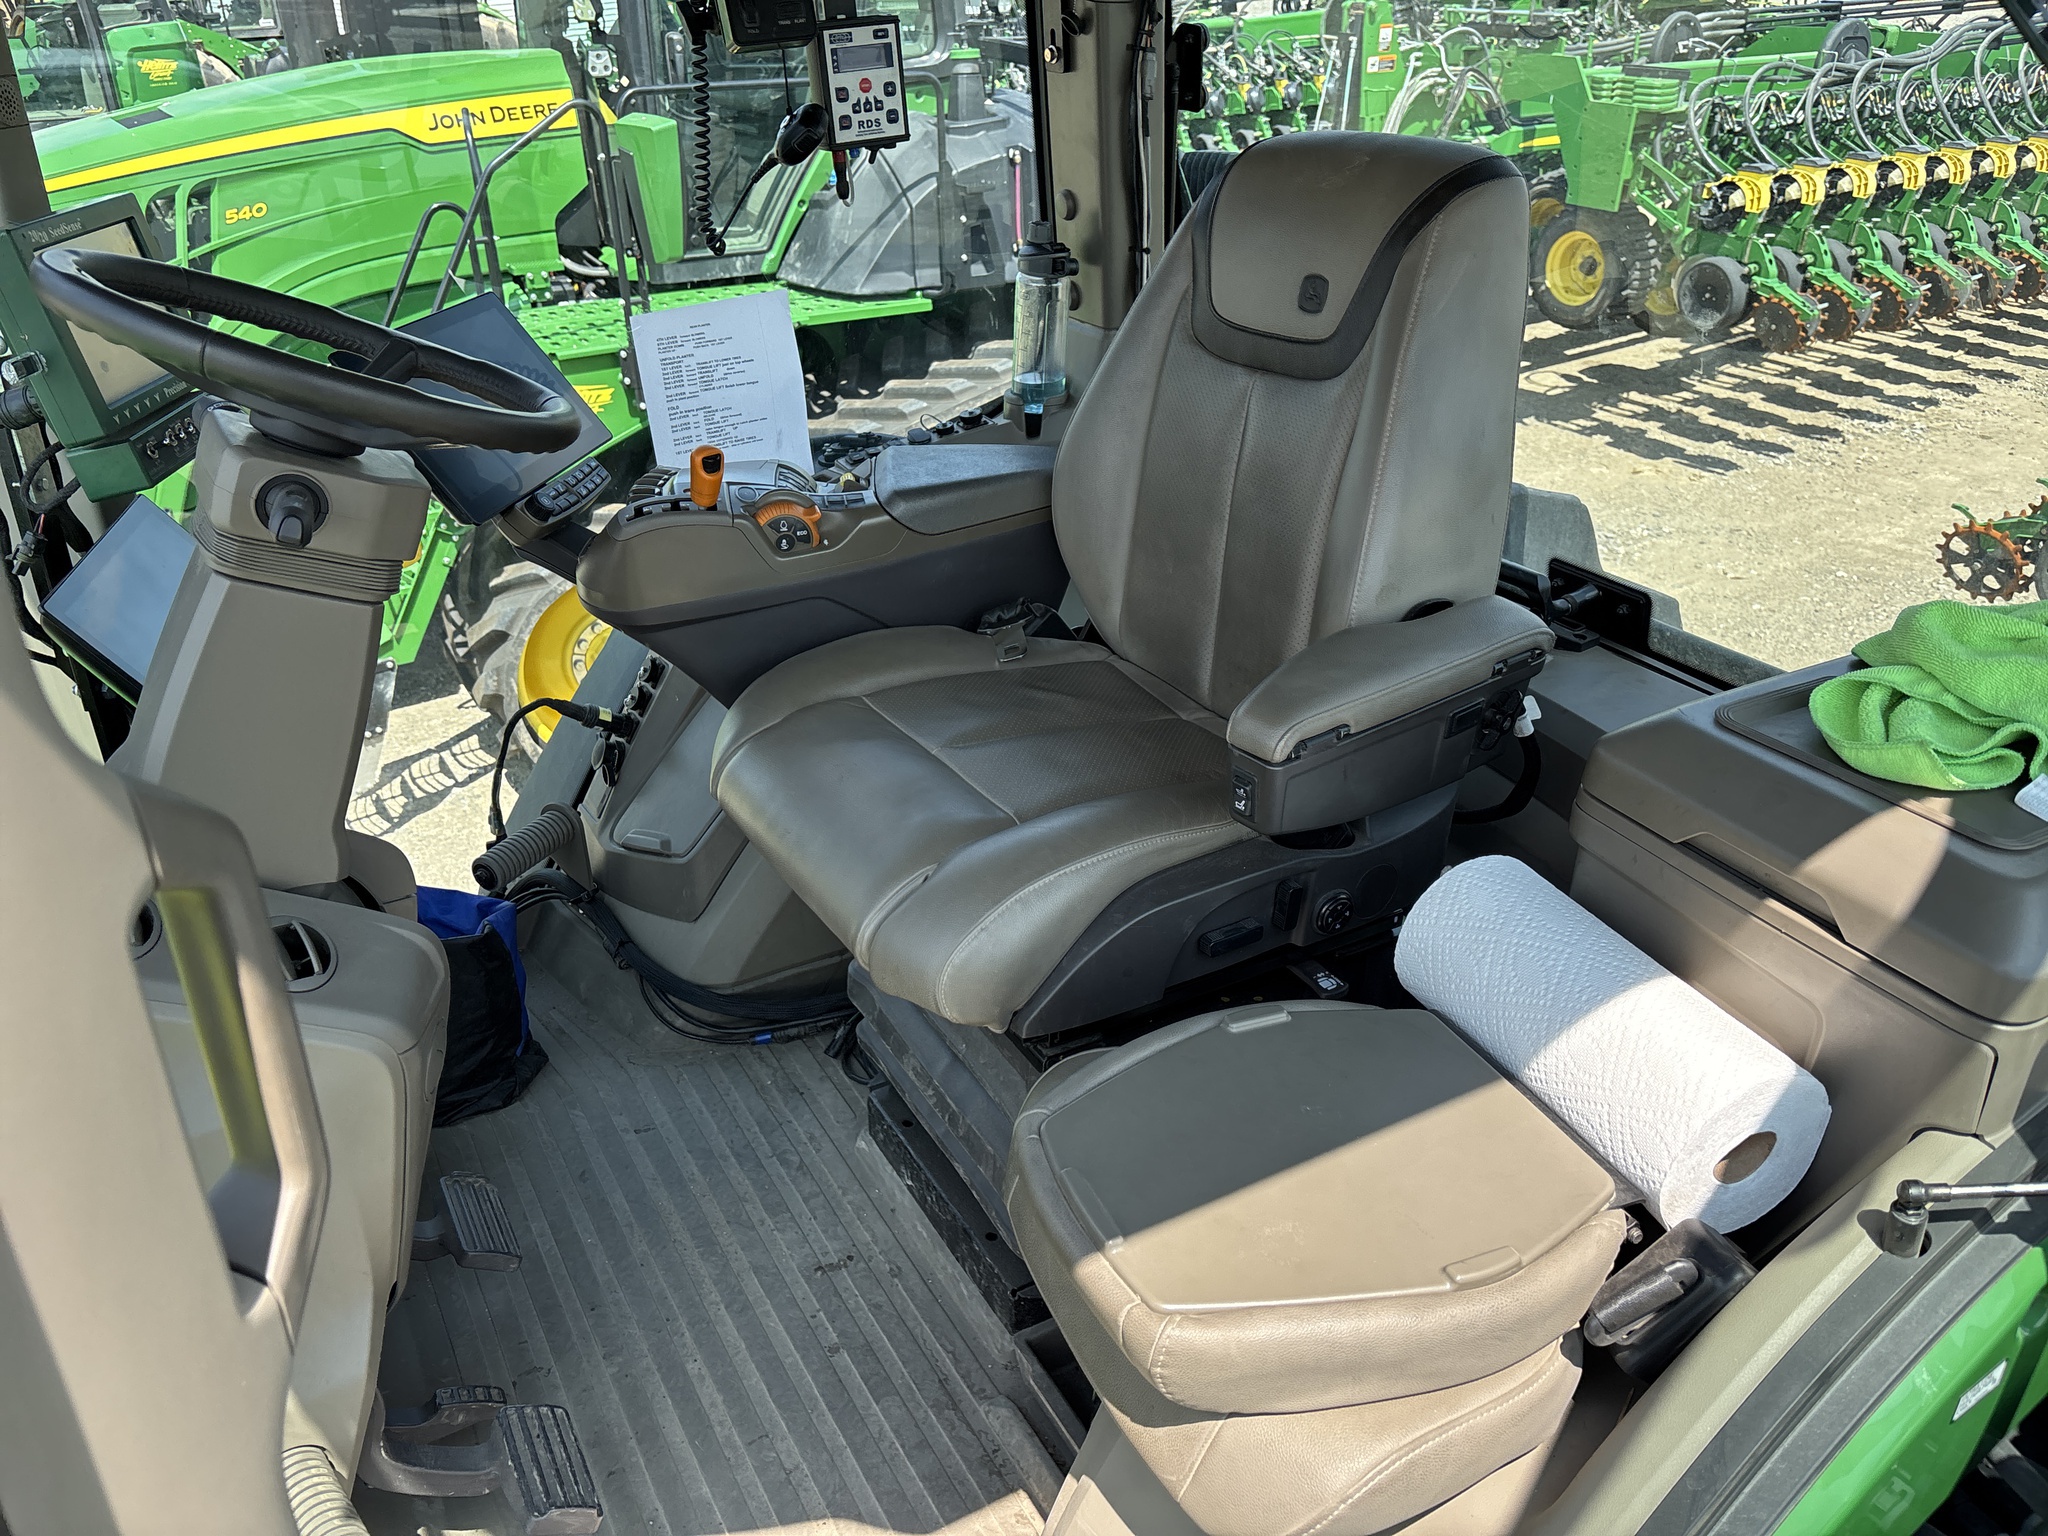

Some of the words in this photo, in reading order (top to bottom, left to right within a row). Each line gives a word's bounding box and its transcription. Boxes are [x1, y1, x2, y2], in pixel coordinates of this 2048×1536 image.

[428, 110, 486, 131] JOHN
[490, 102, 558, 123] DEERE
[858, 118, 882, 130] RDS
[224, 202, 268, 224] 540
[48, 222, 82, 238] SeedSense
[163, 380, 188, 398] Precision
